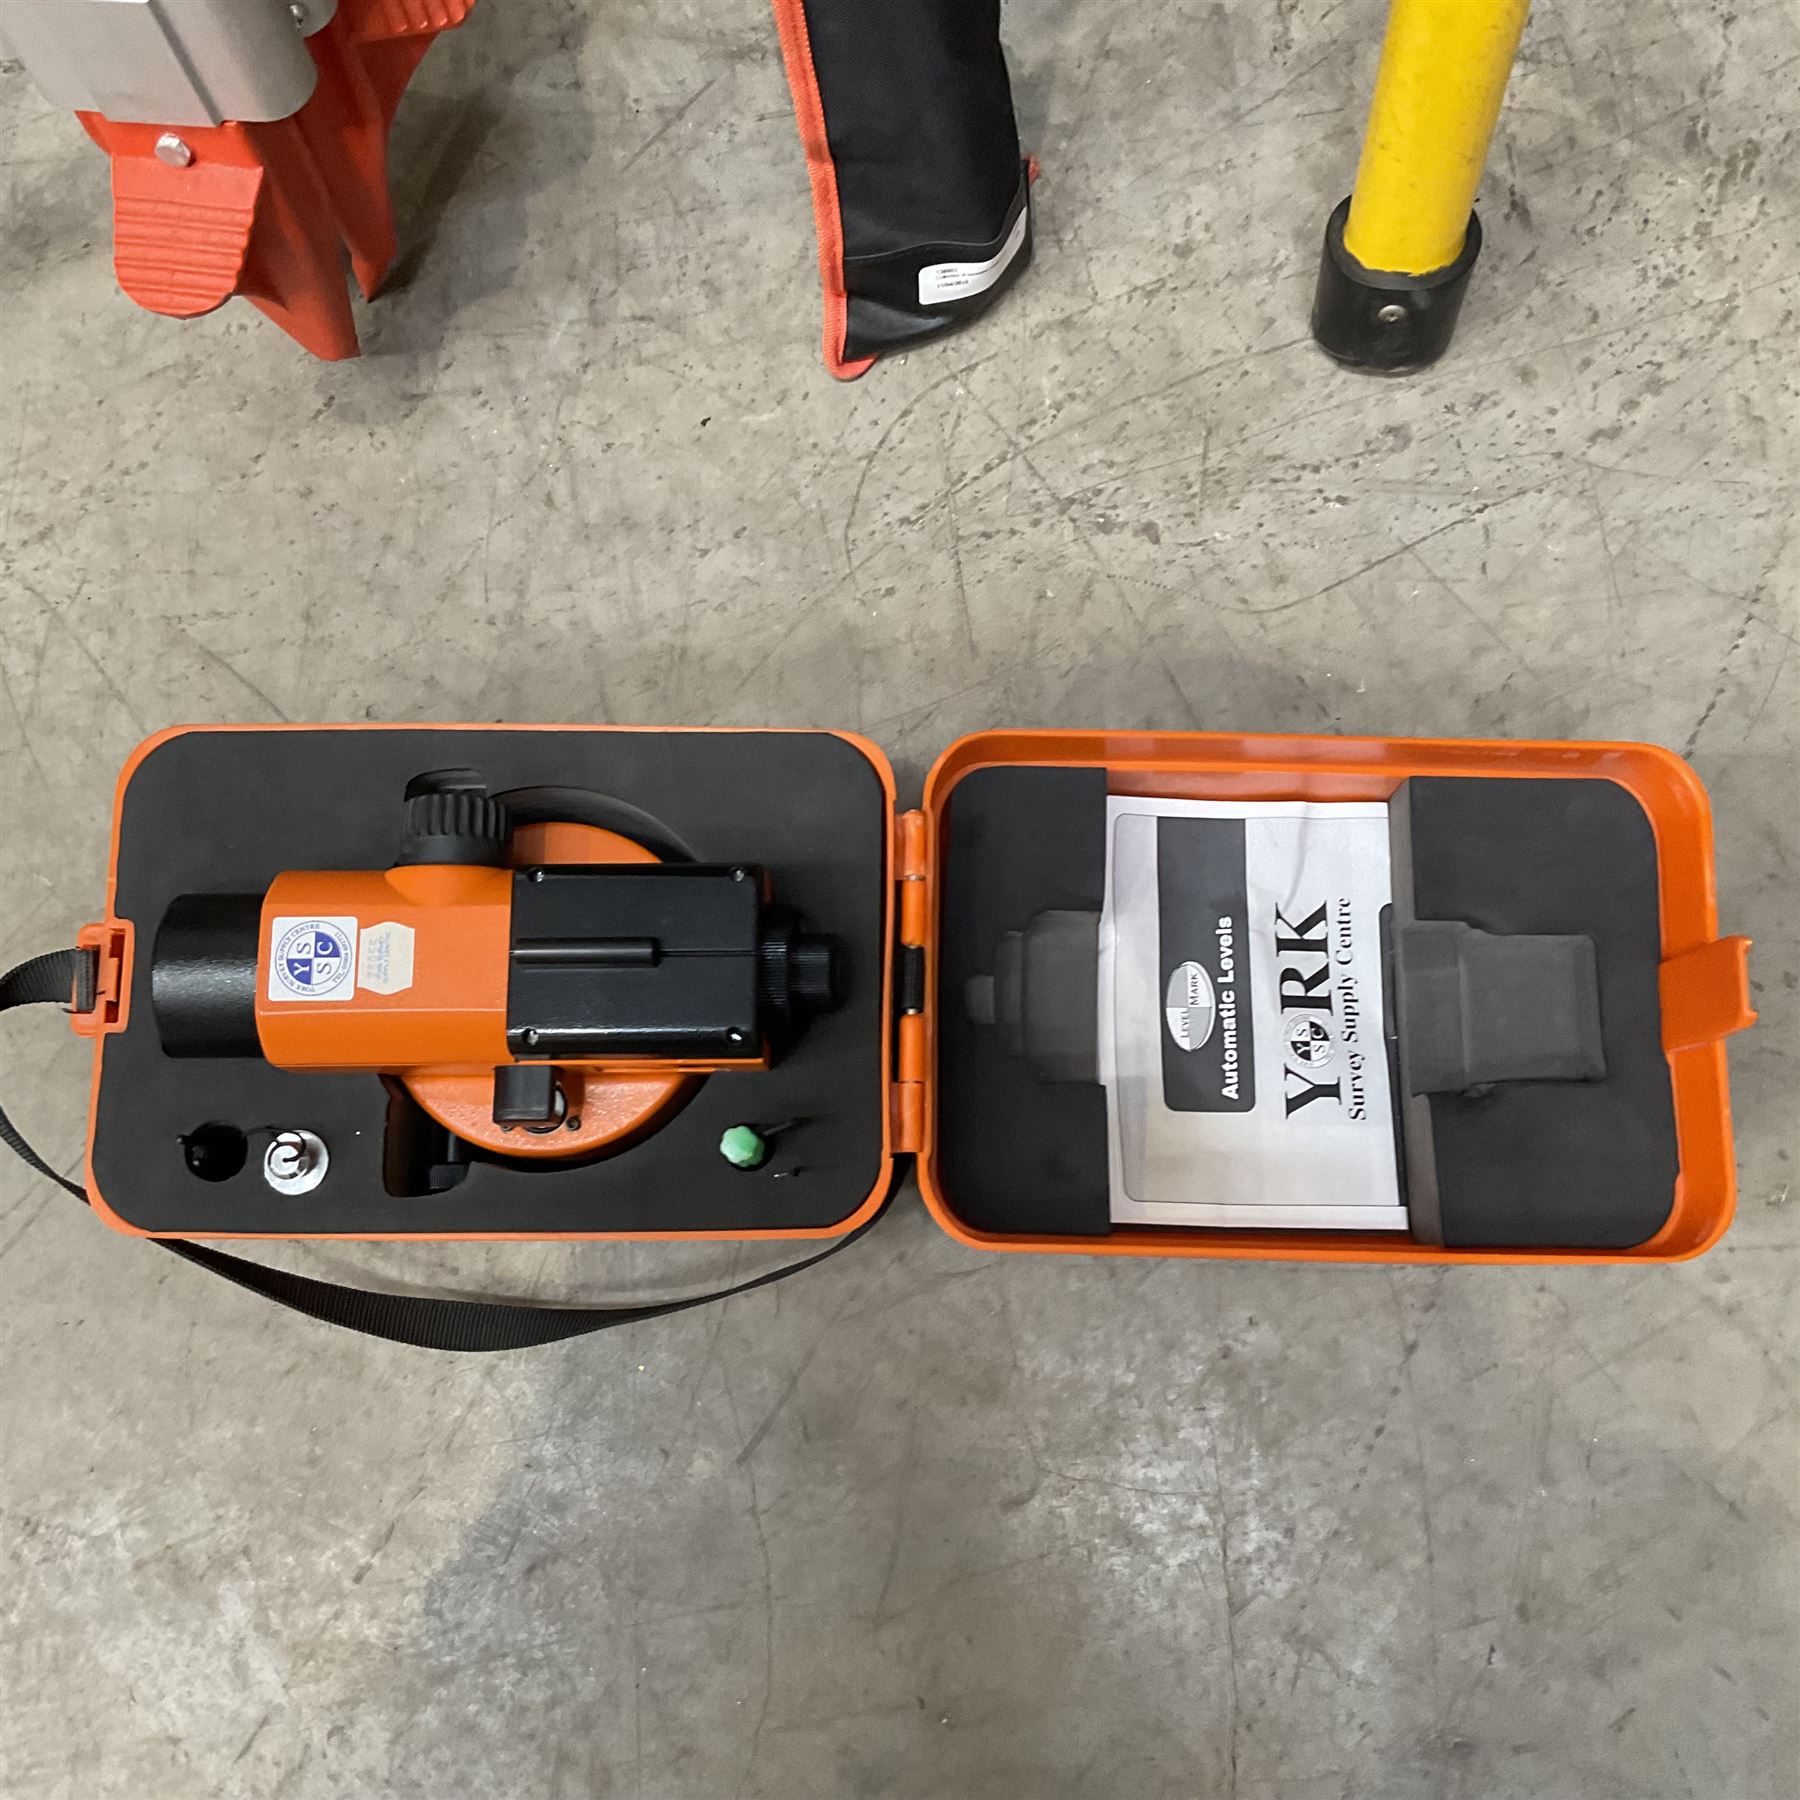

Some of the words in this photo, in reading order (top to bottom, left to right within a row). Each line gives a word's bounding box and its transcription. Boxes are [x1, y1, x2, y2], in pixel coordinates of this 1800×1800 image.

[296, 942, 312, 955] S
[316, 941, 333, 955] C
[1215, 916, 1235, 983] Levels
[1336, 898, 1353, 965] Centre
[293, 962, 310, 977] Y
[316, 962, 332, 975] S
[1190, 973, 1200, 1006] MARK
[1337, 973, 1360, 1043] Supply
[1219, 990, 1239, 1100] Automatic
[1349, 1050, 1367, 1120] Survey
